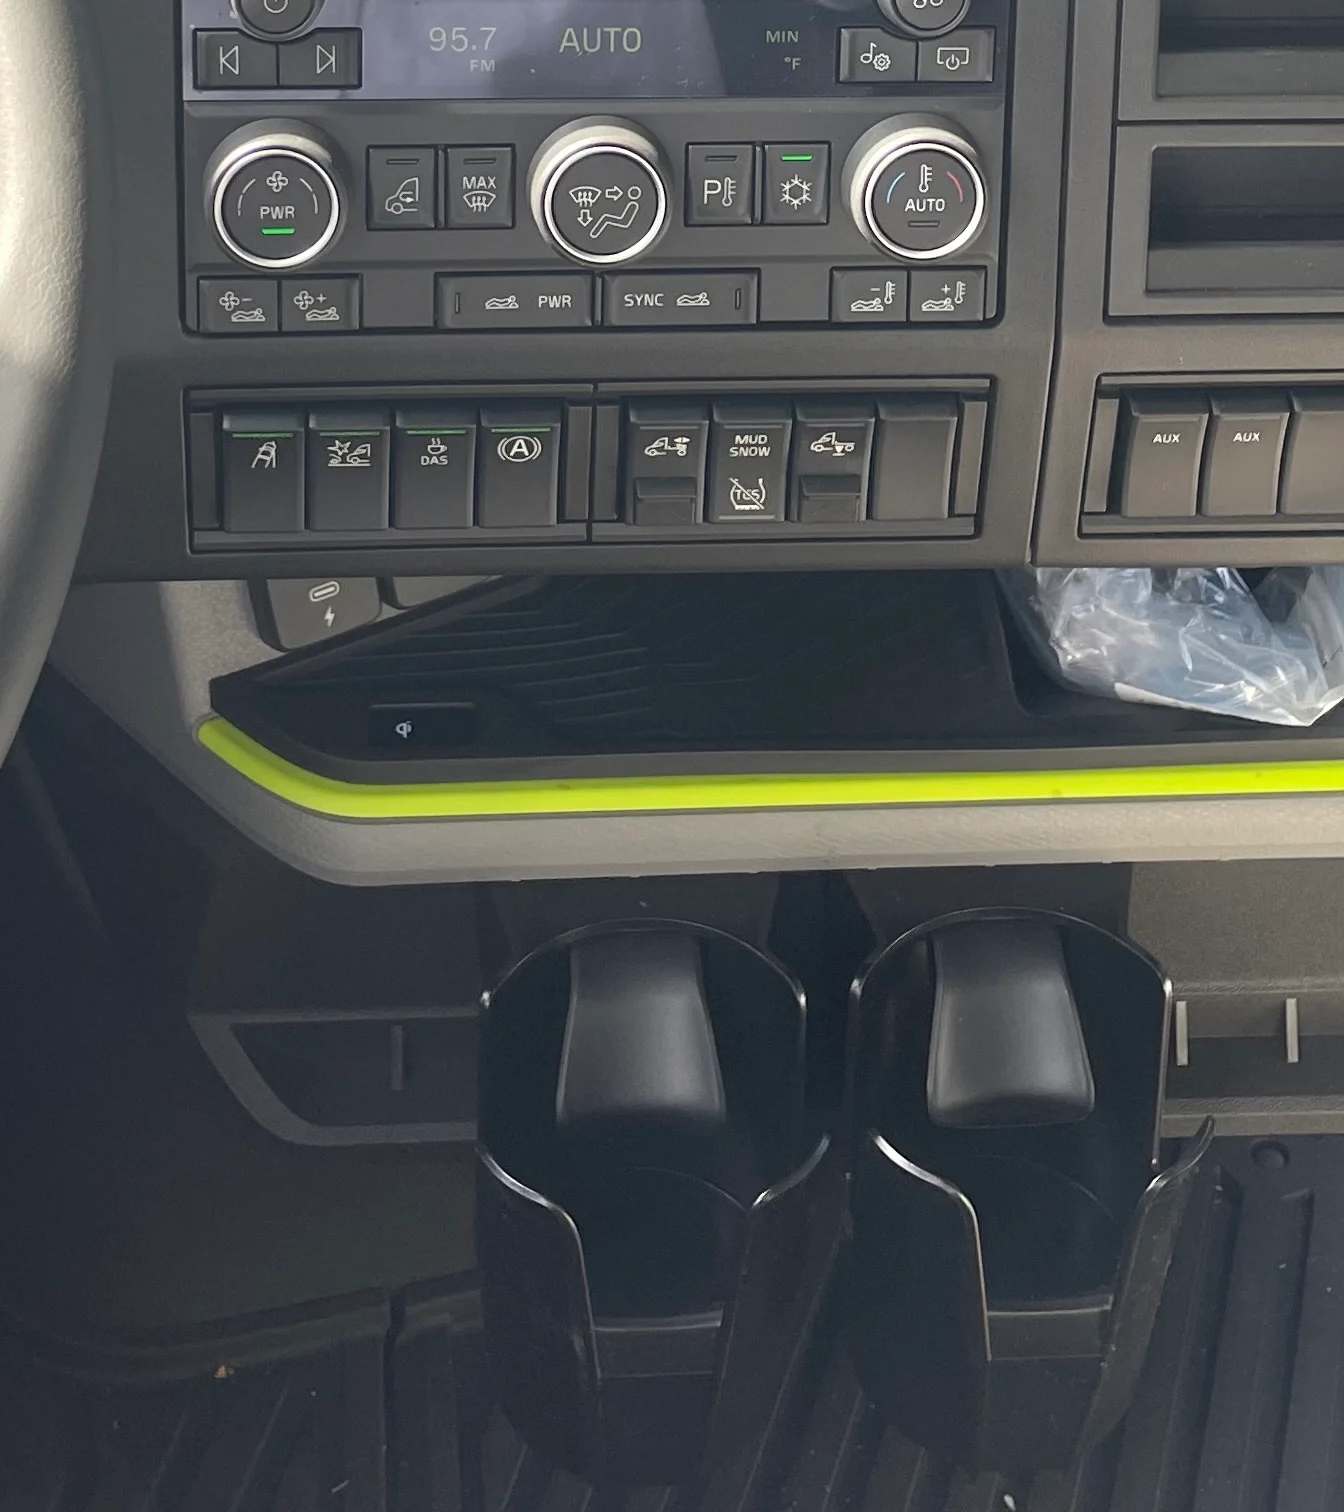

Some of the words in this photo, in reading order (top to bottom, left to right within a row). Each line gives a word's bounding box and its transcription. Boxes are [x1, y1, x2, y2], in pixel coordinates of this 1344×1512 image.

[428, 26, 497, 52] 95.7
[559, 26, 642, 53] AUTO
[765, 30, 799, 44] MIN
[469, 59, 496, 72] FM
[462, 176, 497, 190] MAX
[703, 179, 722, 205] P
[904, 198, 946, 213] AUTO
[260, 206, 296, 221] PWR
[537, 294, 572, 309] PWR
[623, 293, 664, 307] SYNC
[734, 434, 768, 445] MUD
[1152, 433, 1181, 444] AUX
[1232, 432, 1261, 443] AUX
[509, 439, 530, 457] A
[729, 446, 771, 457] SNOW
[420, 455, 449, 467] DAS
